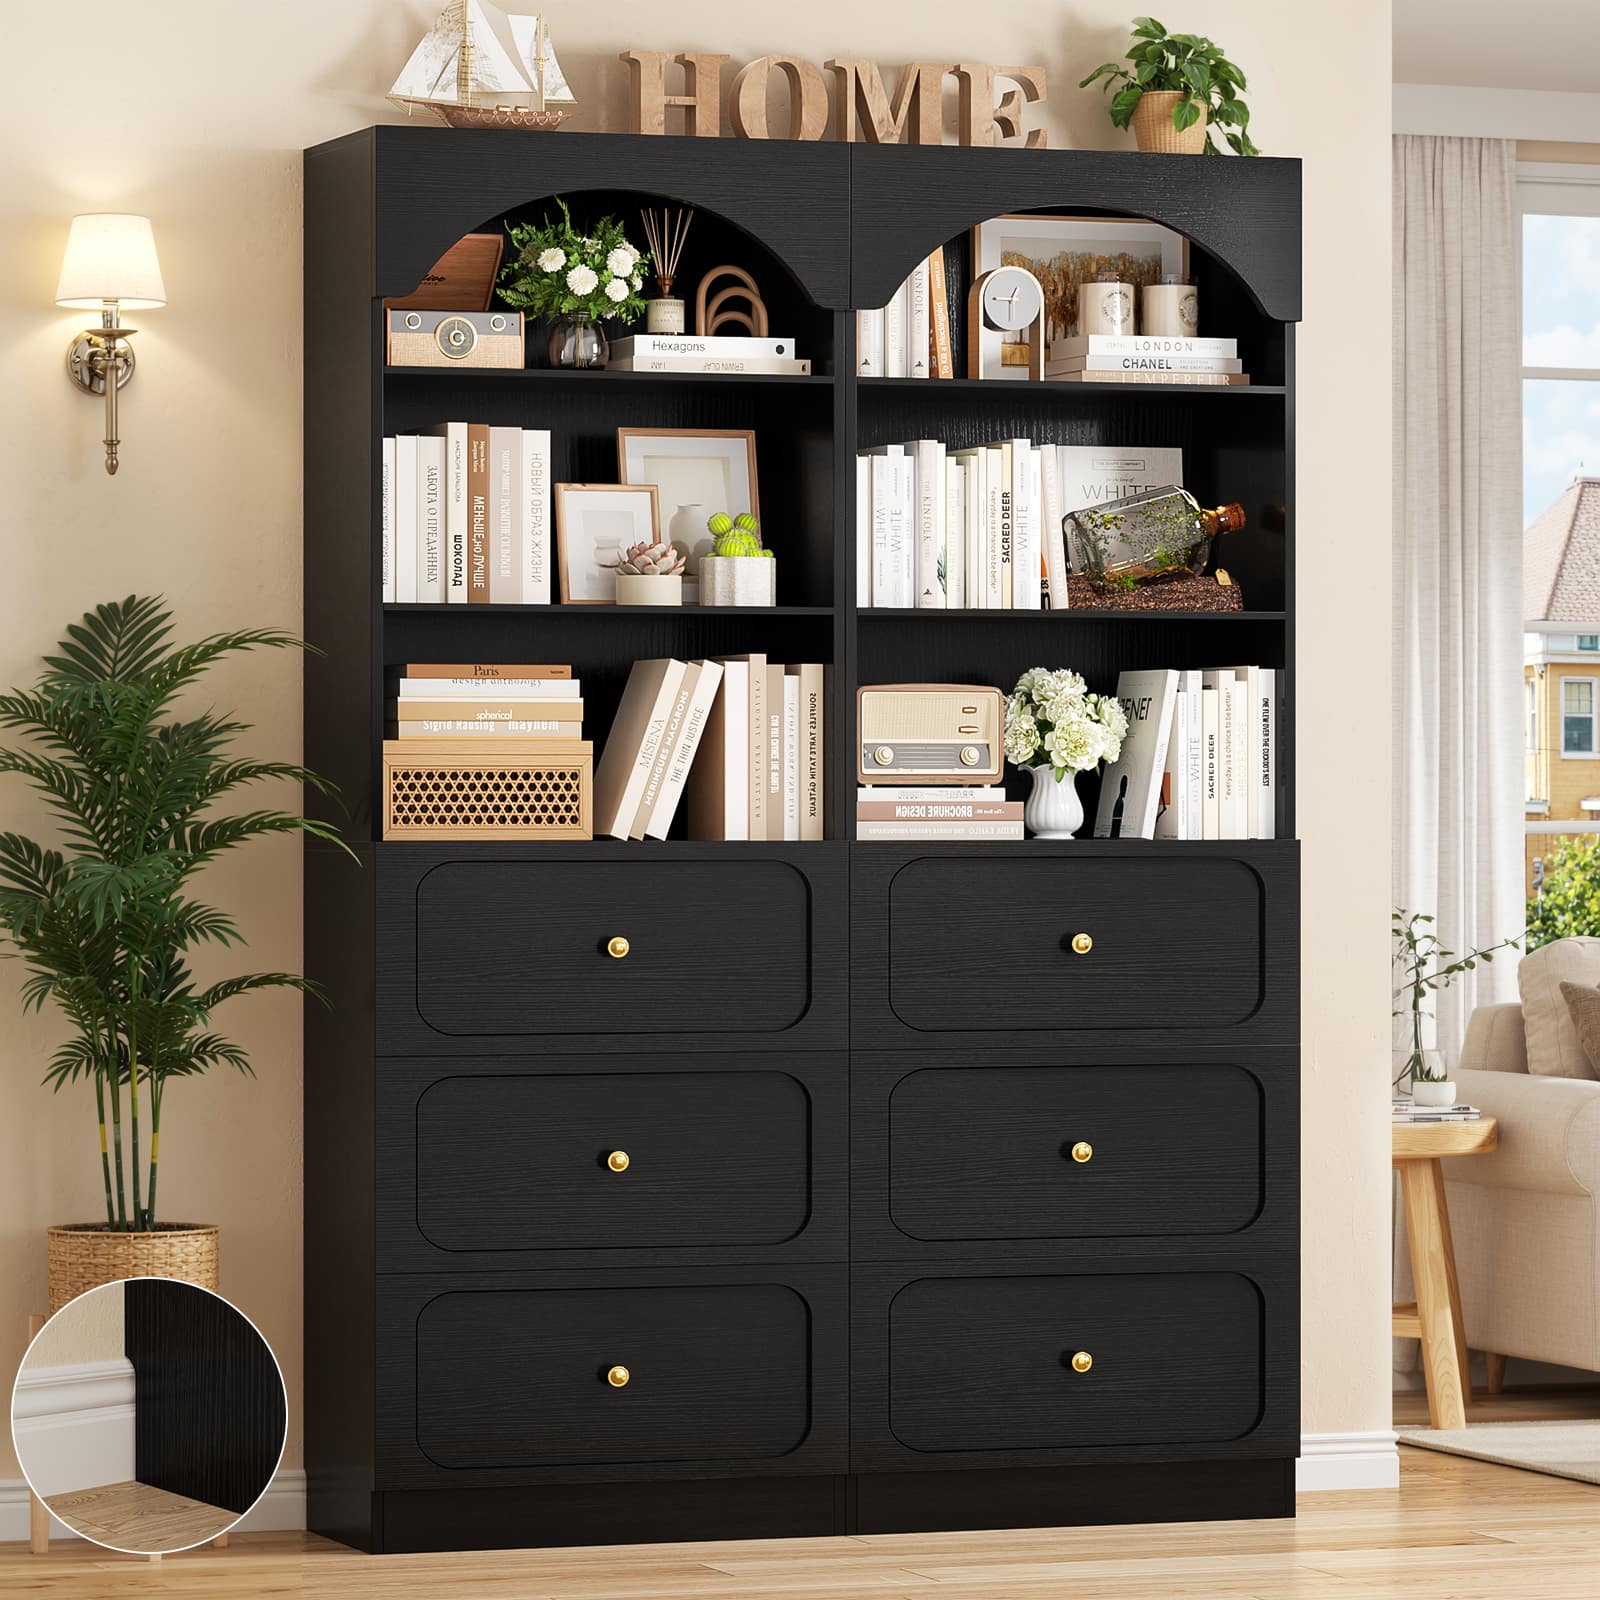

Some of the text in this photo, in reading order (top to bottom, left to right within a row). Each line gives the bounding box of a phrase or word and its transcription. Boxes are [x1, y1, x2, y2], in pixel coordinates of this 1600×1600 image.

[619, 50, 1048, 149] HOME
[937, 302, 947, 346] Mockingbird
[652, 340, 706, 354] Hexagons
[1122, 358, 1172, 370] CHANEL
[1135, 340, 1193, 352] LONDON
[426, 465, 438, 584] ЗАБОТА О ПРЕДАННЫХ
[531, 453, 544, 583] НОВЫЙ ОБРАЗ ЖИЗНИ
[876, 508, 887, 549] WHITE
[890, 509, 902, 552] WHITE
[923, 496, 932, 542] KINFOLK
[1002, 491, 1010, 563] SACRED DEER
[1016, 505, 1028, 550] WHITE
[452, 534, 463, 587] ШОКОЛАД
[473, 554, 485, 588] ЛУЧШЕ
[452, 679, 543, 688] design anthology
[474, 664, 500, 676] Paris
[476, 709, 513, 720] spherical
[665, 691, 689, 746] MACARONS
[1262, 697, 1270, 708] ONE
[1262, 709, 1270, 723] FLEW
[424, 720, 453, 732] Sigrid
[670, 767, 684, 783] THE
[686, 706, 704, 742] JUSTICE
[1262, 724, 1270, 737] OVER
[1262, 738, 1270, 747] THE
[1190, 737, 1201, 782] WHITE
[1262, 773, 1270, 787] NEST
